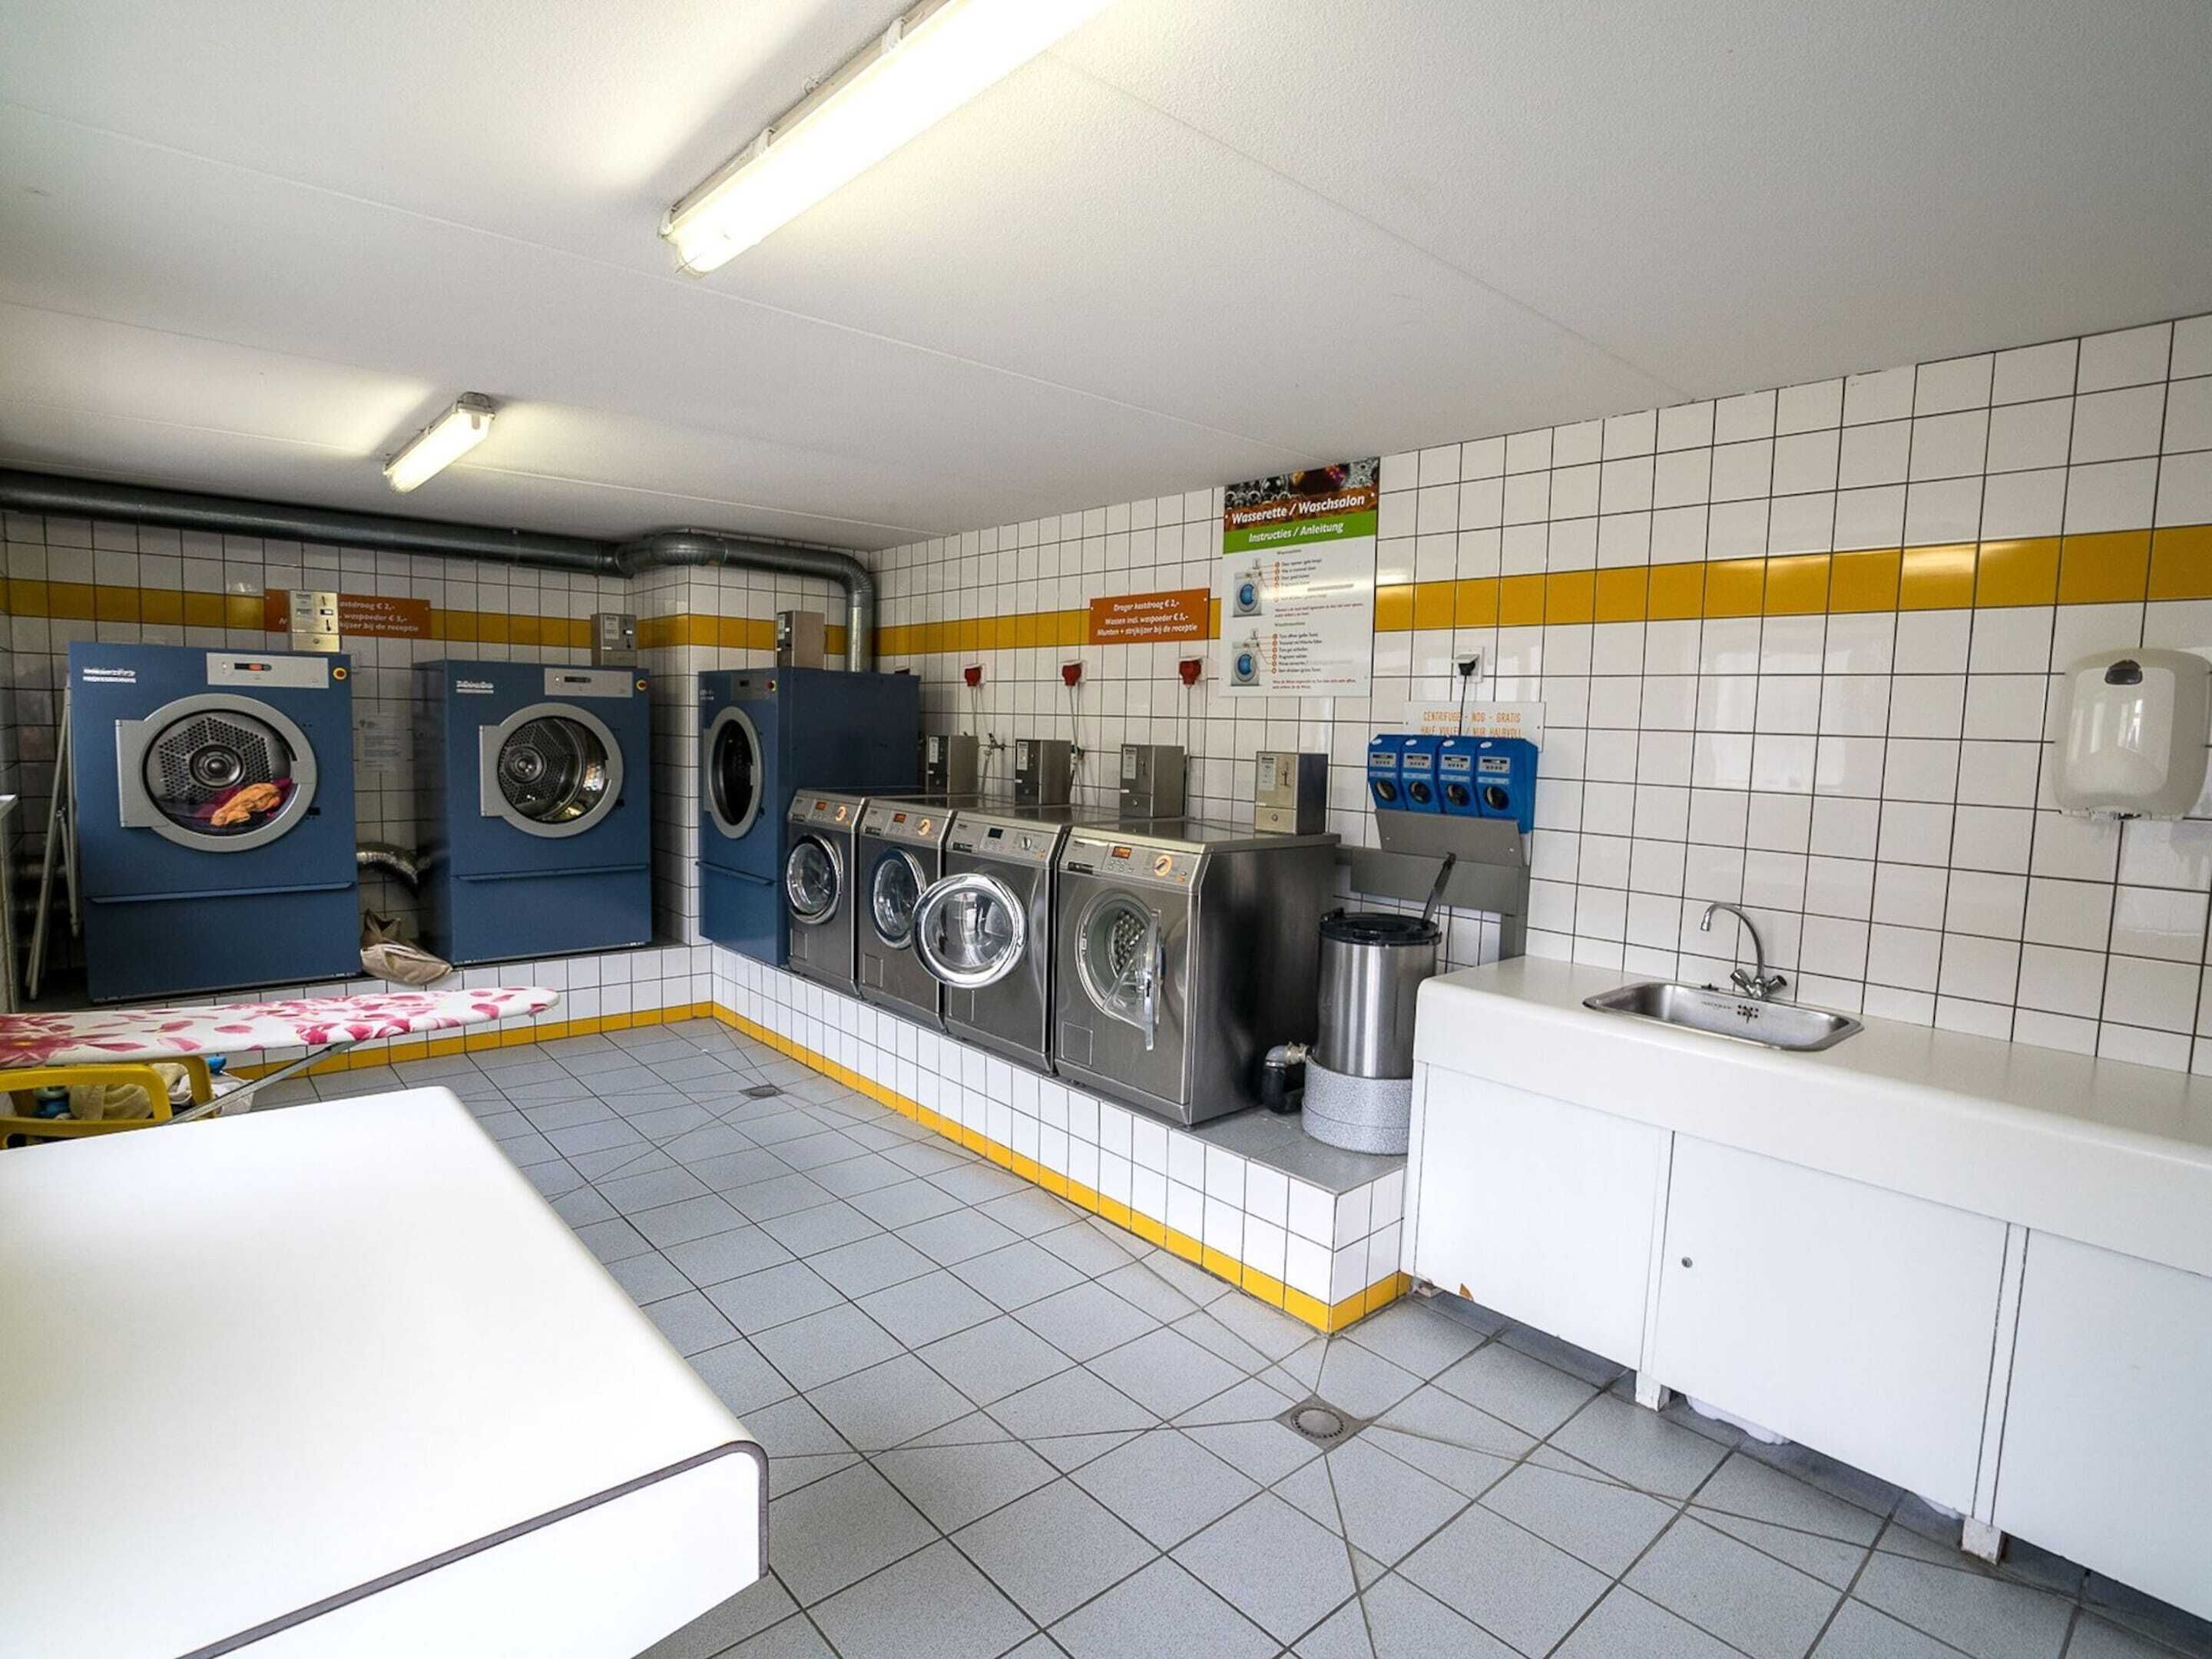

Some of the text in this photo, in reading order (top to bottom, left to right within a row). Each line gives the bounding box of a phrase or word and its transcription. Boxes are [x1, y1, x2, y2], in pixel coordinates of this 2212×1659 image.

[1232, 494, 1365, 525] Wasserette / Waschsalon
[1248, 522, 1344, 543] Instructies / Anleitung
[1105, 618, 1126, 626] Wassen
[1163, 624, 1171, 633] de
[1171, 622, 1198, 633] receptie
[1496, 712, 1521, 723] GRATIS
